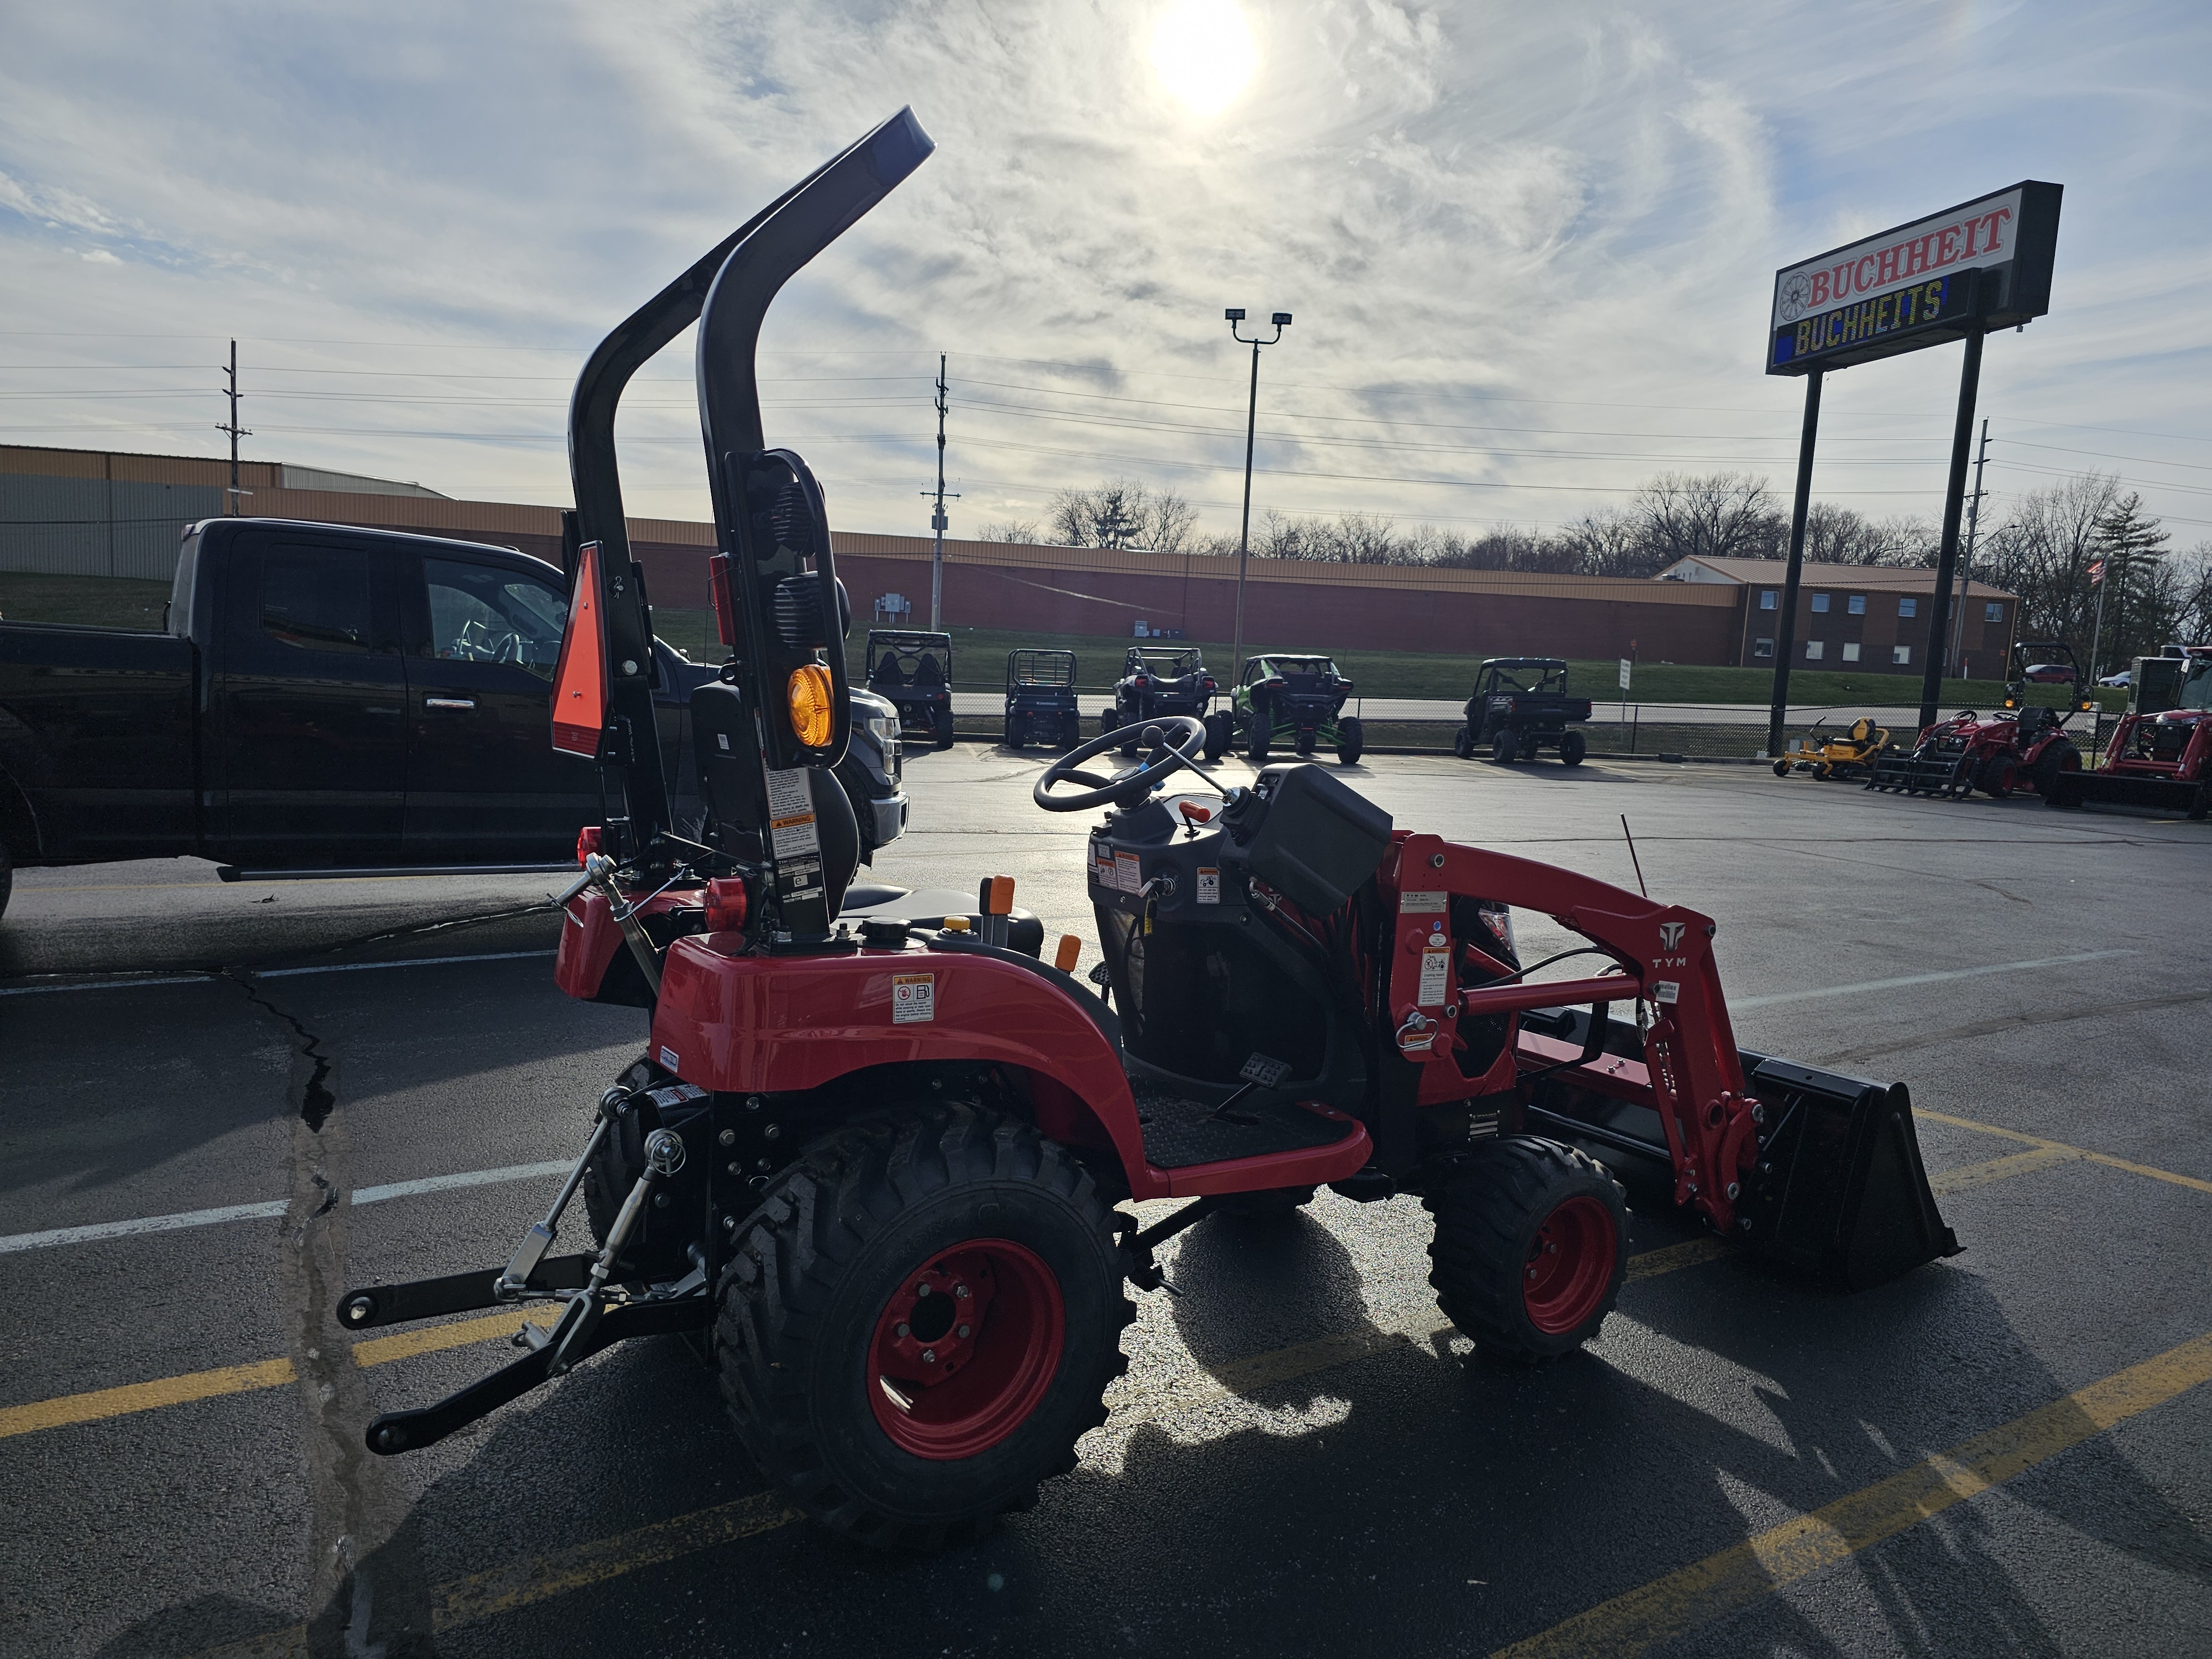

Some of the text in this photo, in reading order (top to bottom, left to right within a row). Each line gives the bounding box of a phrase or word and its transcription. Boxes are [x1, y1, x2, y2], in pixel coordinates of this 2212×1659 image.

[1807, 207, 2011, 309] BUCHHEIT
[1794, 280, 1942, 357] BUCHHEITS
[783, 816, 811, 825] WARNING
[795, 877, 802, 885] e
[1652, 957, 1686, 968] TYM
